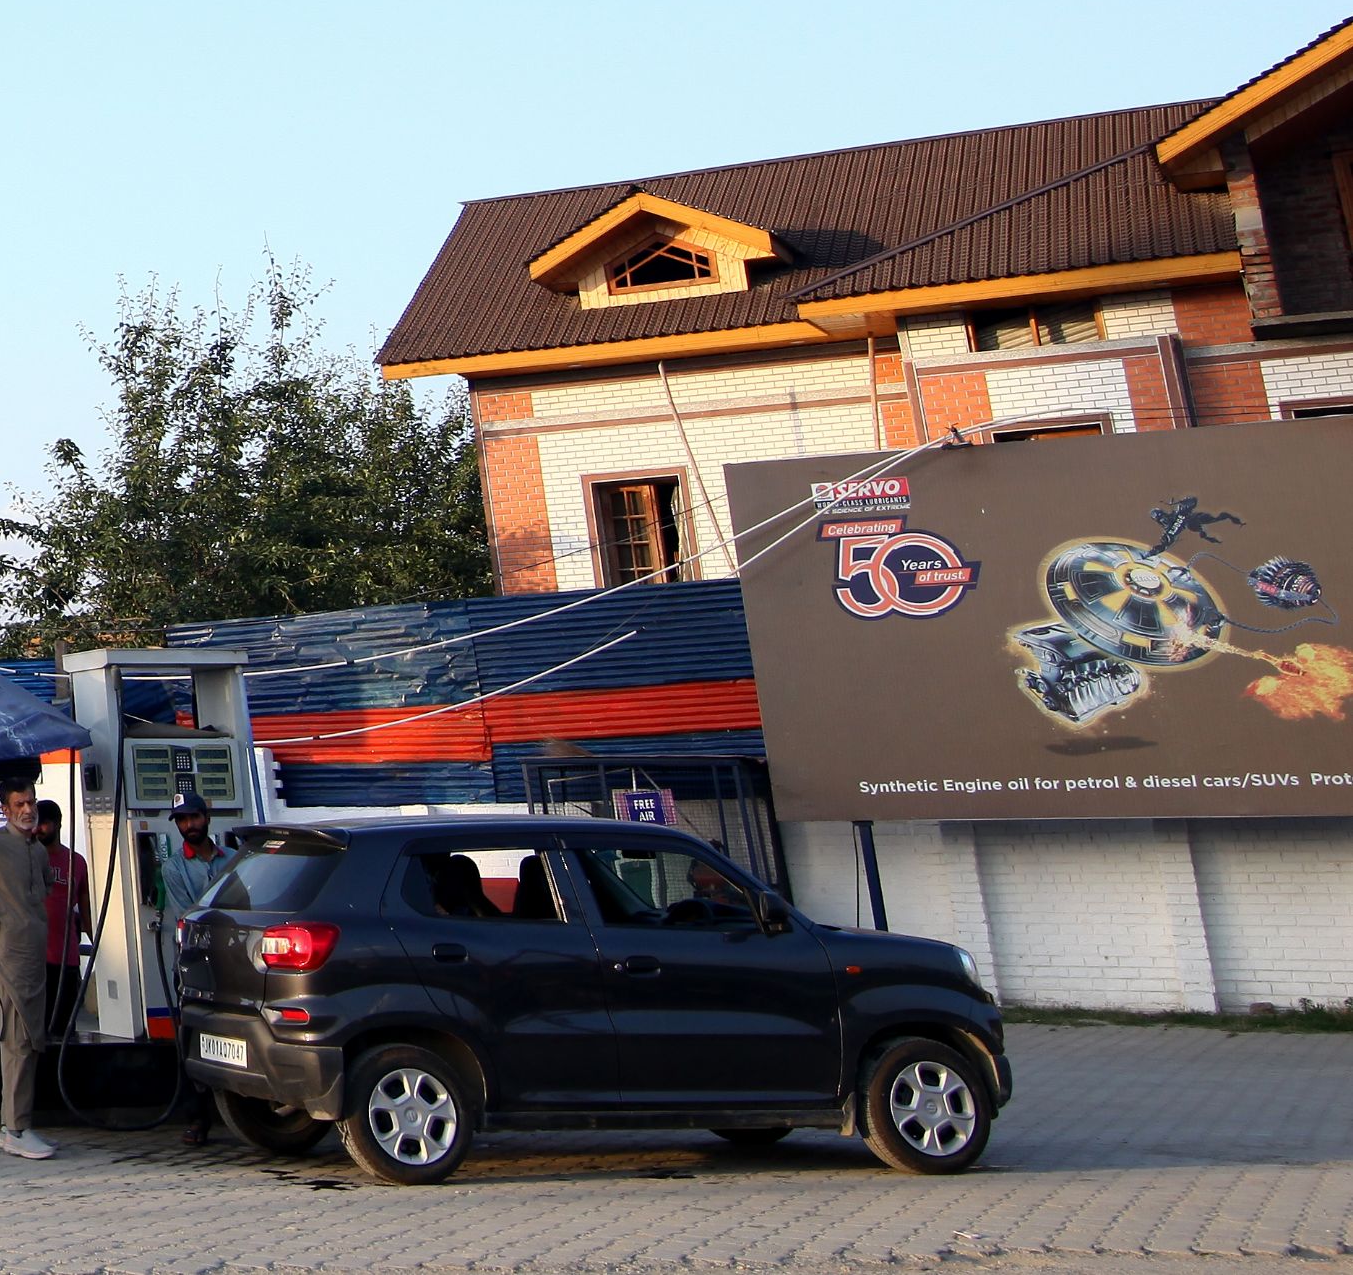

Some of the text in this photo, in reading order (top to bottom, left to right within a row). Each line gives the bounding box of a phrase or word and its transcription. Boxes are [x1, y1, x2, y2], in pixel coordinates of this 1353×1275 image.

[836, 479, 900, 498] SERVO
[866, 496, 907, 506] LUBRICANTS
[864, 505, 875, 513] OF
[876, 504, 911, 512] EXTREME
[828, 522, 896, 535] Celebrating
[901, 559, 942, 571] Years
[836, 533, 963, 617] 50
[918, 569, 966, 582] of trust.
[859, 772, 1353, 794] Synthetic Engine oil for petrol & diesel cars/SUVs Prot
[633, 799, 655, 810] FREE
[639, 811, 656, 821] AIR
[205, 1039, 244, 1062] JK01AQ7047
